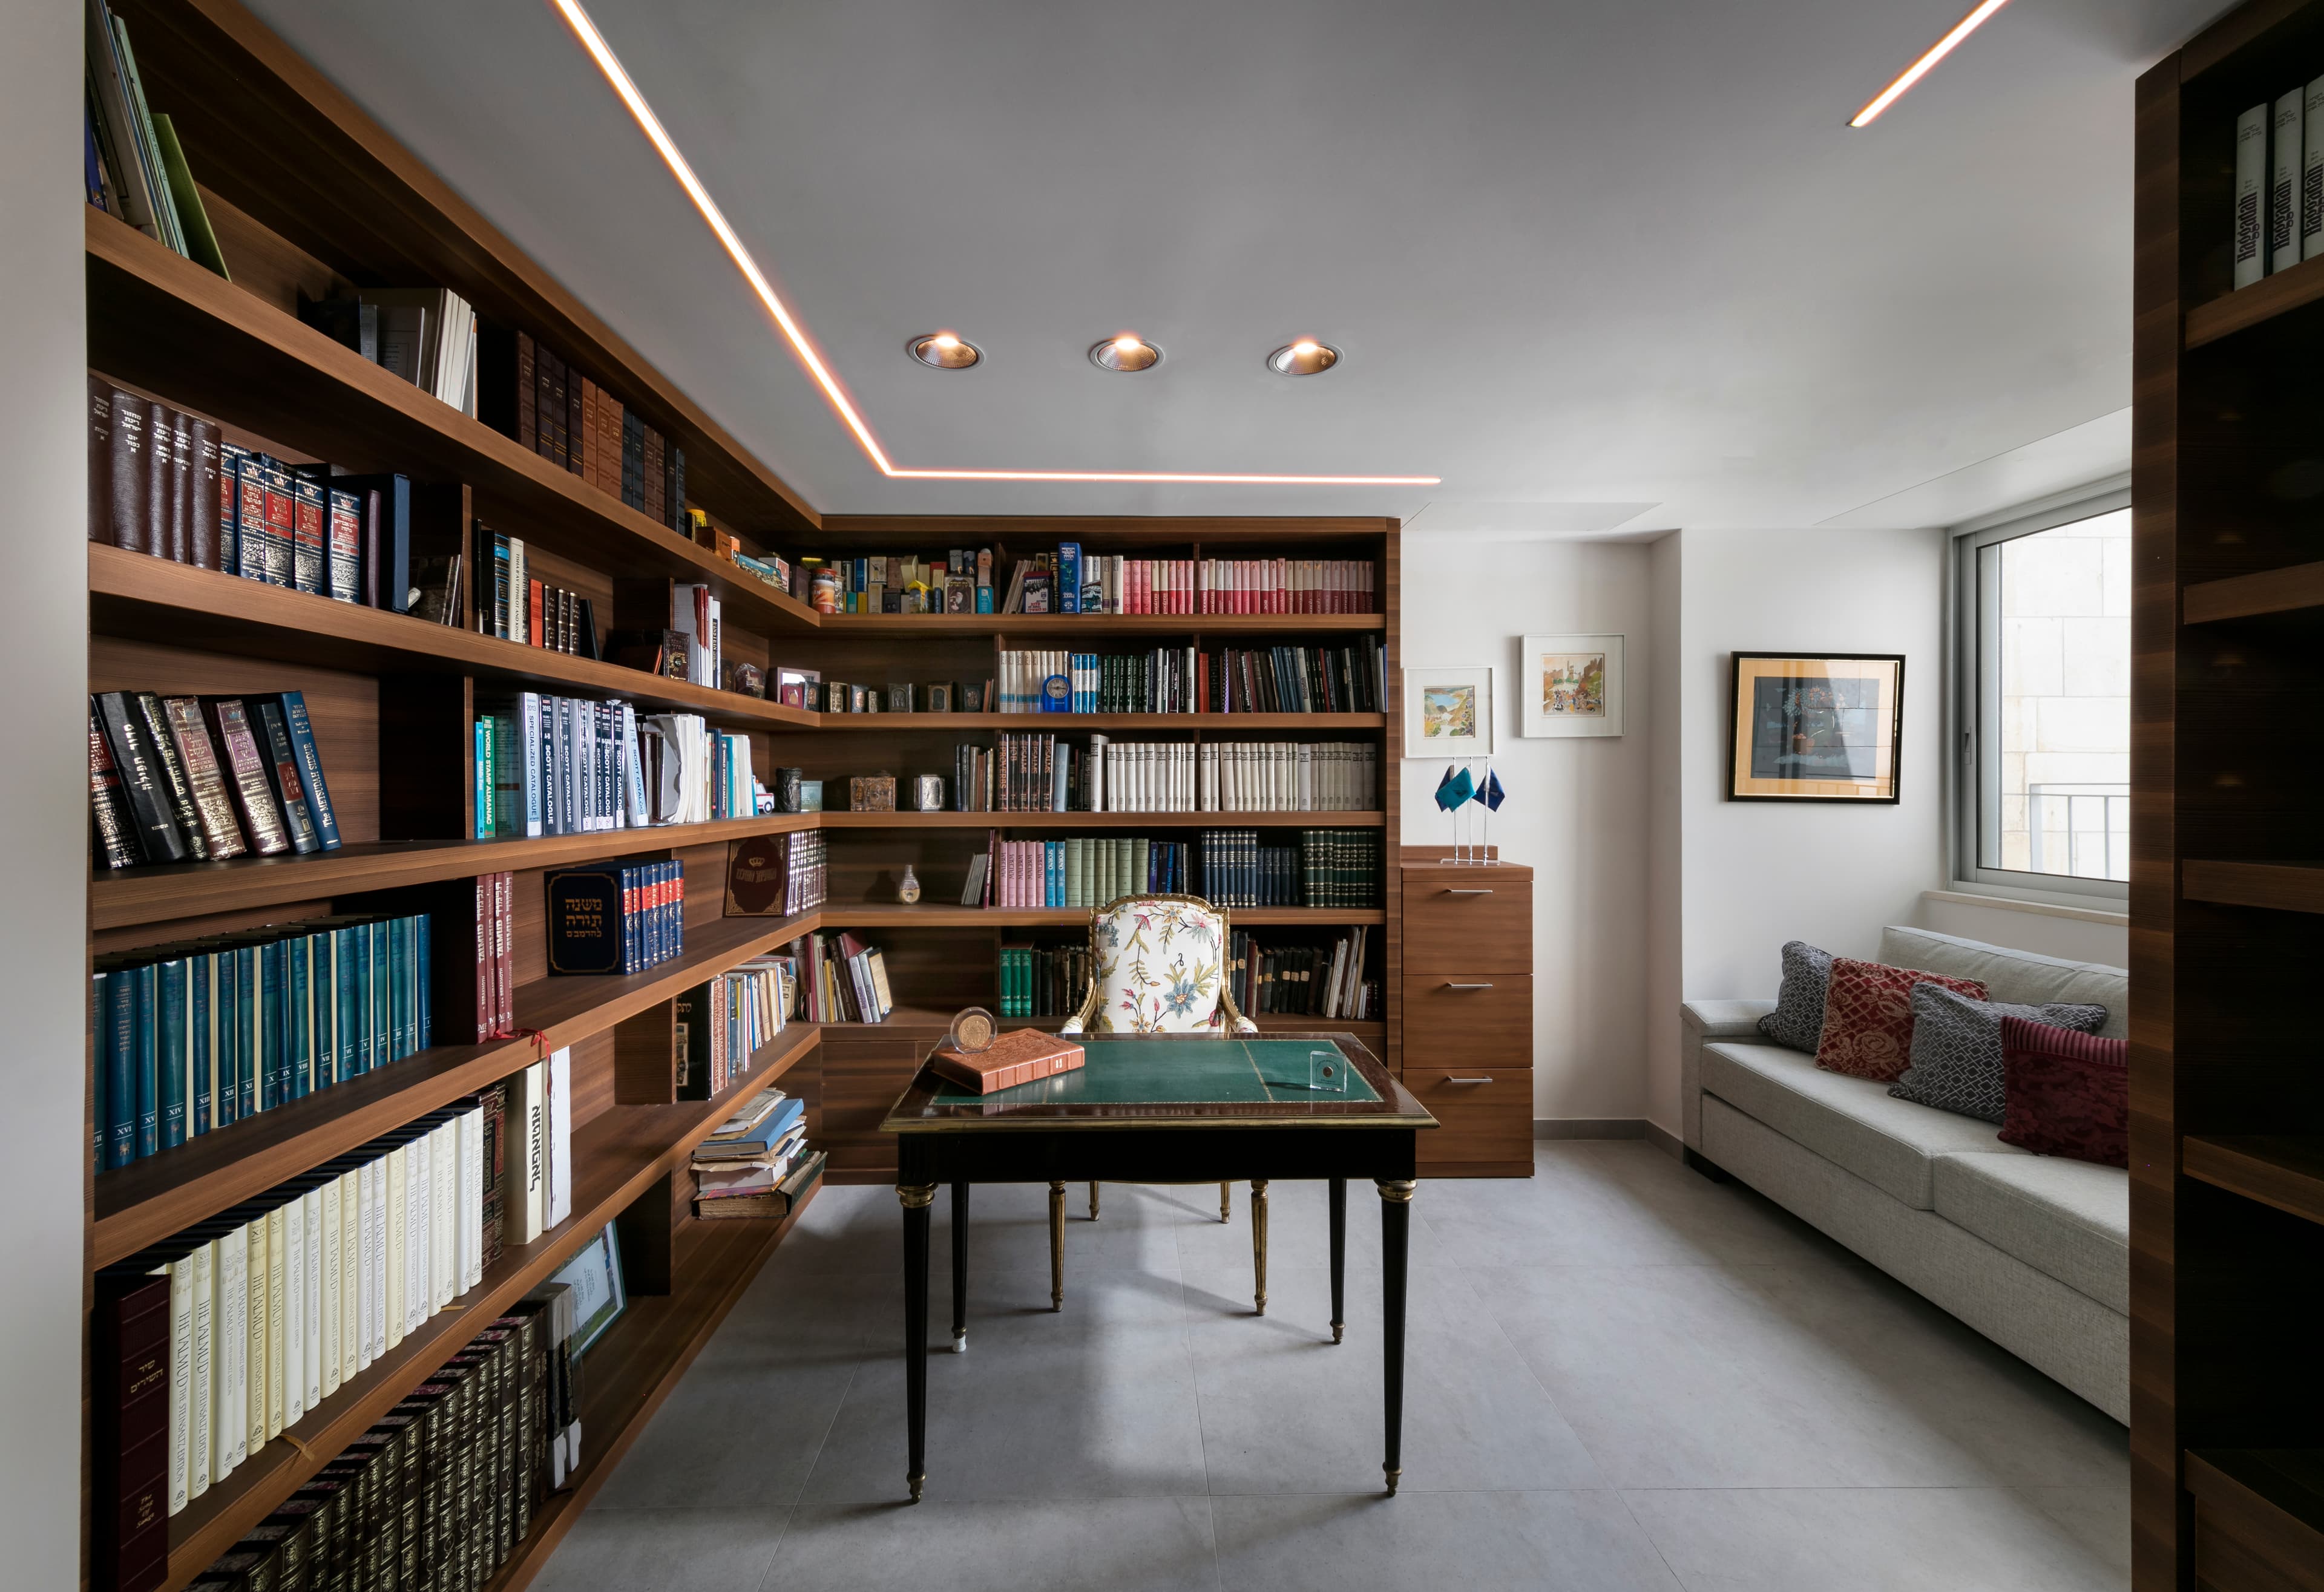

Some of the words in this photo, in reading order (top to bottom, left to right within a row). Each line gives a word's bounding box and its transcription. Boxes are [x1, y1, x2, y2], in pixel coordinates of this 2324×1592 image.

[2304, 163, 2324, 238] Haggadah
[2274, 179, 2294, 252] Haggadah
[2237, 191, 2261, 264] Haggadah
[122, 410, 142, 421] מחזור
[125, 416, 140, 426] רינת
[122, 421, 142, 431] ישראל
[154, 422, 172, 432] מחזור
[154, 432, 172, 442] ישראל
[156, 428, 170, 437] רינת
[174, 430, 192, 441] מחזור
[174, 441, 192, 451] ישראל
[176, 436, 191, 446] רינת
[202, 439, 217, 450] מחזור
[156, 449, 172, 460] השנה
[157, 444, 171, 453] ראש
[205, 445, 217, 454] רינת
[202, 450, 217, 460] ישראל
[204, 467, 217, 475] פסח
[303, 742, 318, 771] SIDDUR
[310, 770, 329, 812] METSUDAH
[530, 768, 539, 816] CATALOGUE
[322, 812, 333, 828] The
[565, 898, 602, 911] משנה
[566, 914, 602, 927] תורה
[857, 986, 867, 1009] Haggadah
[409, 1024, 414, 1032] II
[379, 1035, 386, 1044] IV
[346, 1046, 352, 1055] VI
[322, 1054, 330, 1063] VII
[282, 1068, 290, 1077] IX
[298, 1061, 309, 1072] VIII
[269, 1074, 274, 1083] X
[245, 1082, 253, 1091] XI
[225, 1089, 234, 1098] XII
[199, 1094, 211, 1106] XIII
[169, 1105, 183, 1116] XIV
[145, 1115, 156, 1125] XV
[116, 1124, 132, 1136] XVI
[376, 1204, 386, 1222] THE
[347, 1219, 356, 1238] THE
[375, 1222, 385, 1261] TALMUD
[347, 1237, 356, 1279] TALMUD
[272, 1262, 283, 1283] THE
[253, 1270, 265, 1293] THE
[199, 1297, 211, 1323] THE
[272, 1283, 282, 1328] TALMUD
[180, 1309, 191, 1335] THE
[252, 1292, 265, 1340] TALMUD
[197, 1322, 211, 1374] TALMUD
[138, 1360, 156, 1373] שיר
[177, 1335, 191, 1386] TALMUD
[130, 1368, 164, 1394] השירים
[140, 1493, 153, 1505] The
[139, 1499, 154, 1514] Song
